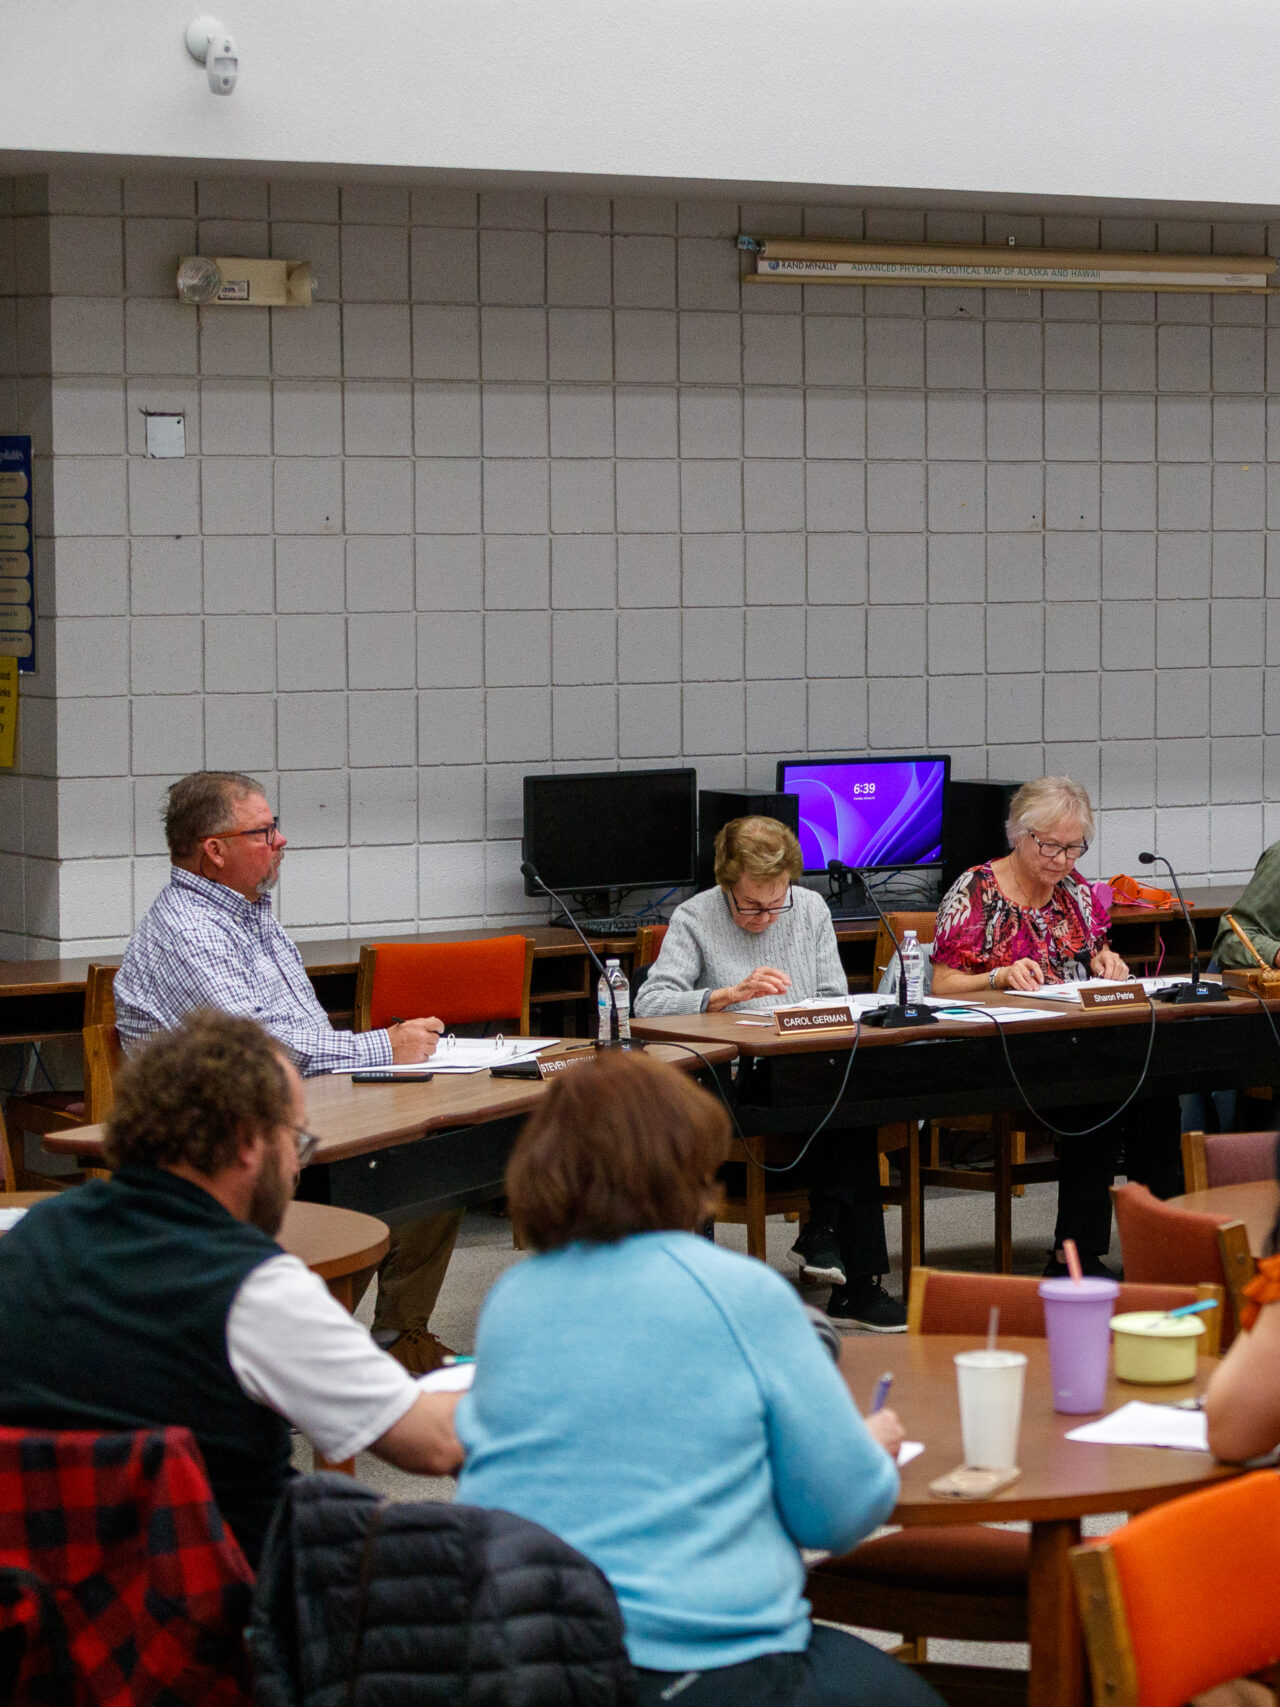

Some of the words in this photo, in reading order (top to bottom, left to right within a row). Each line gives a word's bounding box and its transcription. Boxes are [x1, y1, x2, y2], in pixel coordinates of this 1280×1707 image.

[781, 260, 804, 270] RAND
[851, 263, 897, 273] ADVANCED
[900, 264, 981, 275] PHYSICAL-POLITICAL
[983, 266, 1002, 275] MAP
[1004, 267, 1015, 276] OF
[1017, 267, 1049, 277] ALASKA
[1051, 269, 1069, 278] AND
[1071, 270, 1101, 279] HAWAII
[853, 783, 876, 795] 6:39
[1093, 993, 1116, 1003] Sharon
[1115, 991, 1135, 1001] Petrie
[783, 1016, 812, 1027] CAROL
[812, 1013, 847, 1025] GERMAN
[540, 1060, 567, 1073] STEVEN
